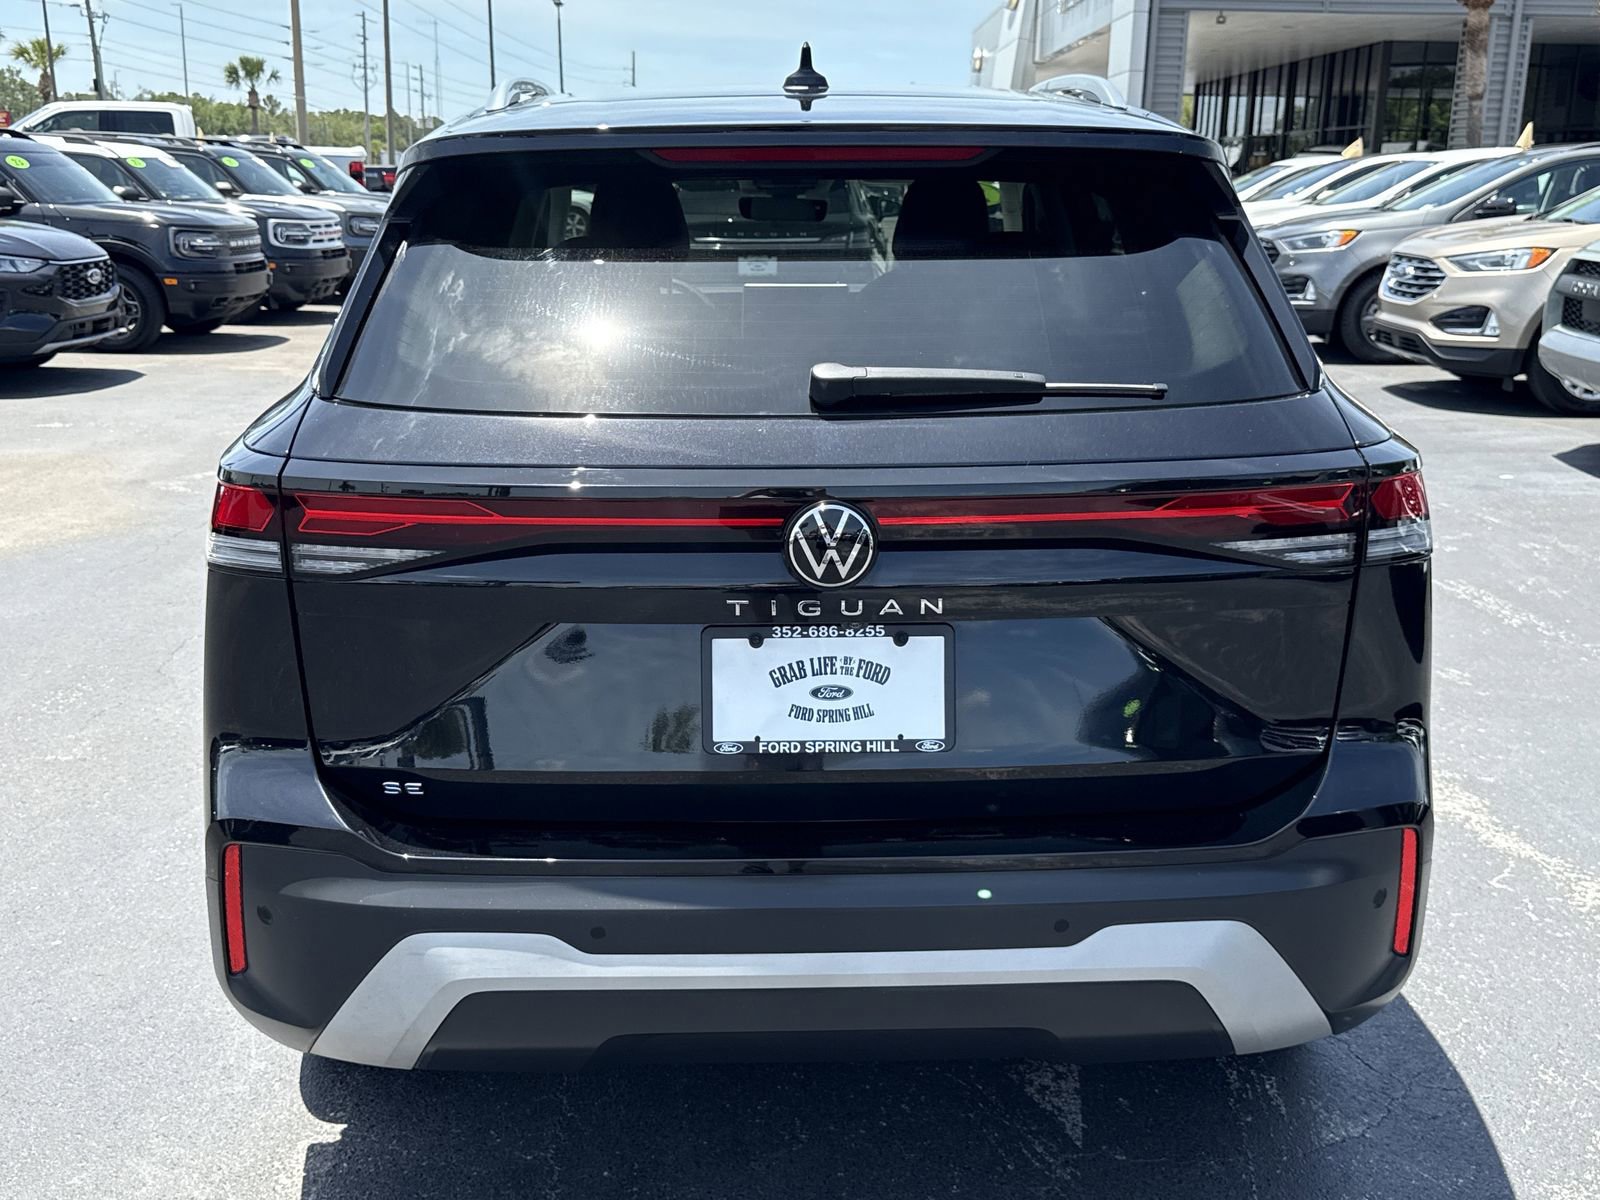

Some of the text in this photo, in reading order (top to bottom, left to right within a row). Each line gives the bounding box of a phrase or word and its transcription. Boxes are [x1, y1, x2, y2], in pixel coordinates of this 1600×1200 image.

[726, 598, 943, 617] TIGUAN
[772, 625, 886, 638] 352-686-8255
[769, 656, 892, 688] GRAB LIFE BY THE FORD
[817, 687, 846, 699] Ford
[788, 703, 875, 723] FORD SPRING HILL
[758, 740, 900, 754] FORD SPRING HILL
[382, 781, 424, 795] SE
